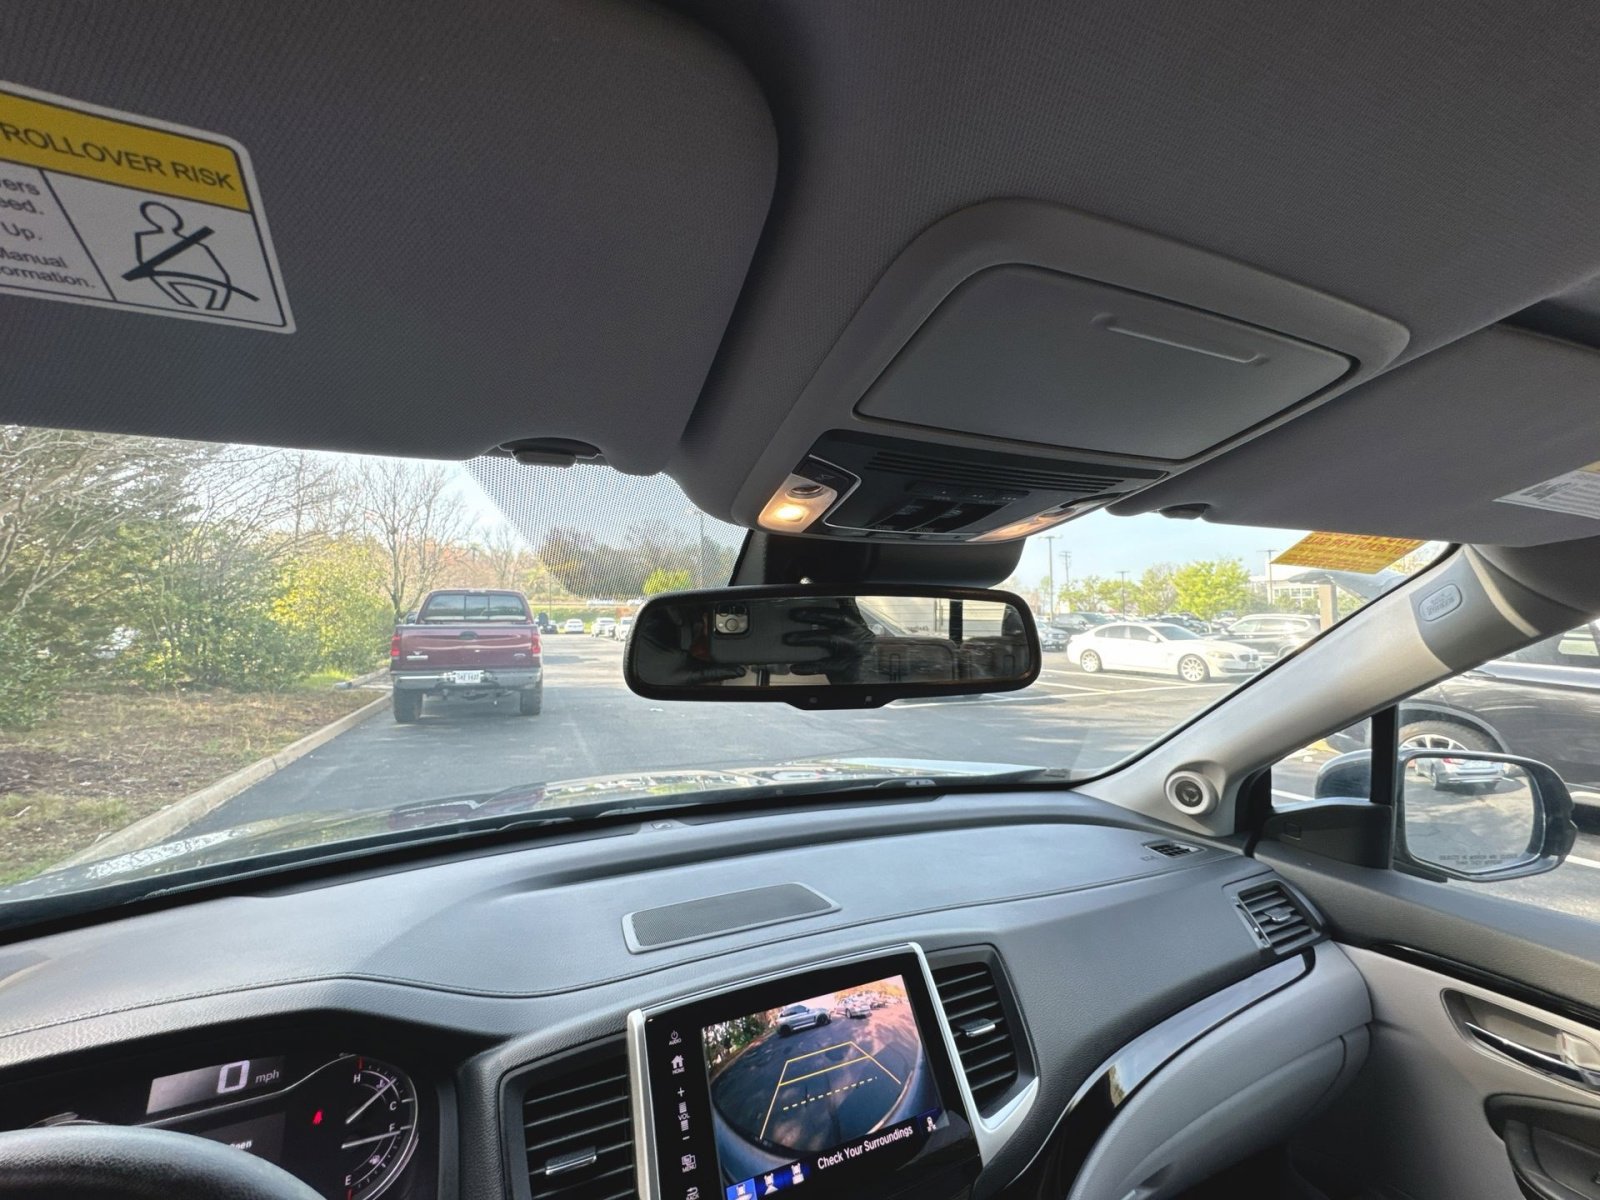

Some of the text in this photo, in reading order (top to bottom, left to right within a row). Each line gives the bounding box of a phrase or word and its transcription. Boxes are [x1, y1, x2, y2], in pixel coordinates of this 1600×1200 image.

[0, 122, 235, 190] ROLLOVER RISK
[1, 221, 43, 241] Up.
[217, 1060, 280, 1094] 0 mph
[353, 1073, 362, 1084] H
[389, 1101, 398, 1111] C
[678, 1113, 690, 1121] VOL
[817, 1125, 914, 1170] Check Your Surroundings
[344, 1174, 352, 1186] E
